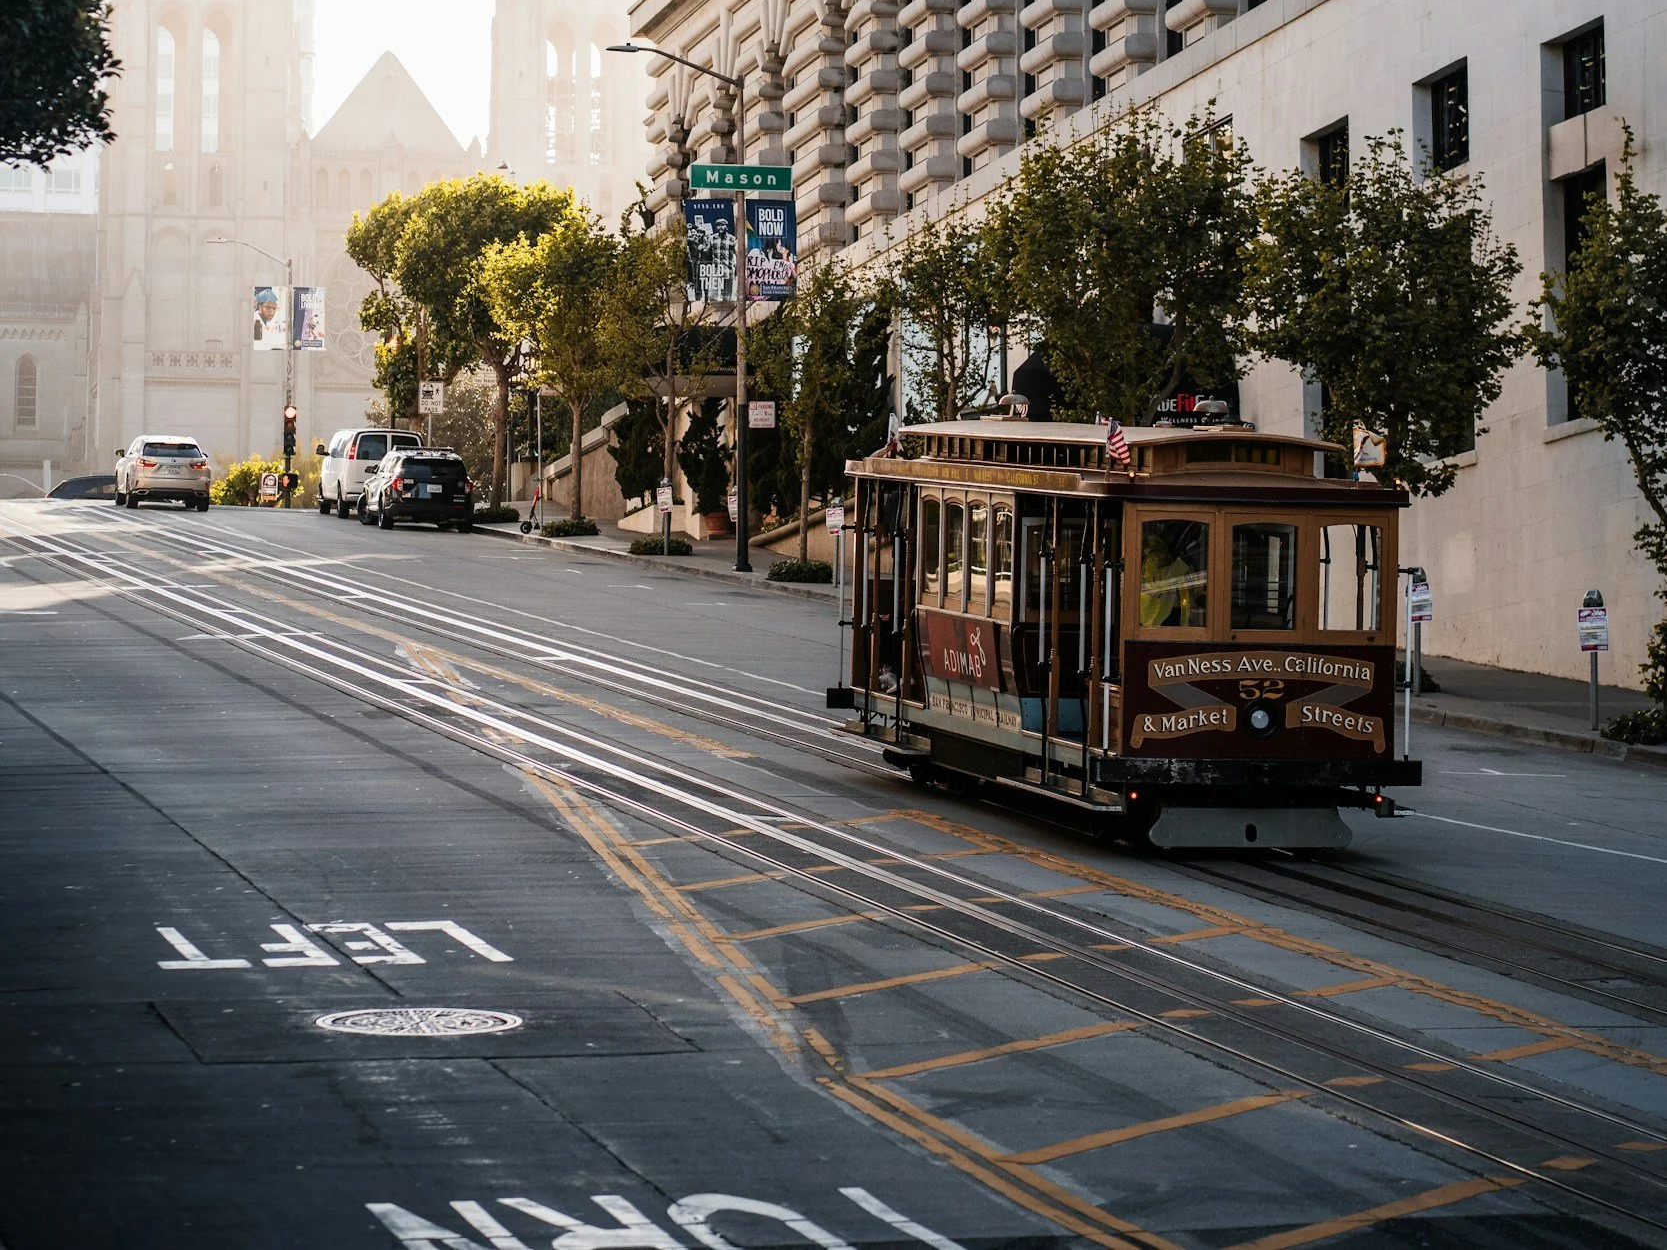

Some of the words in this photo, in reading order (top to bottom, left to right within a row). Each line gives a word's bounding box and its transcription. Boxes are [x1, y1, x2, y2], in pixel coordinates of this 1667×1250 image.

[706, 170, 777, 186] Mason
[758, 208, 784, 222] BOLD
[758, 221, 784, 236] NOW
[700, 263, 724, 277] BOLD
[700, 277, 725, 291] THEN
[944, 648, 982, 678] ADIMAB
[1153, 662, 1186, 680] Van
[1187, 657, 1232, 676] Ness
[1284, 656, 1371, 682] California
[1238, 679, 1285, 700] 52
[998, 711, 1018, 727] AILWAY
[1143, 714, 1157, 732] &
[1161, 708, 1228, 732] Market
[1301, 705, 1375, 734] Streets
[156, 920, 514, 970] LEFT
